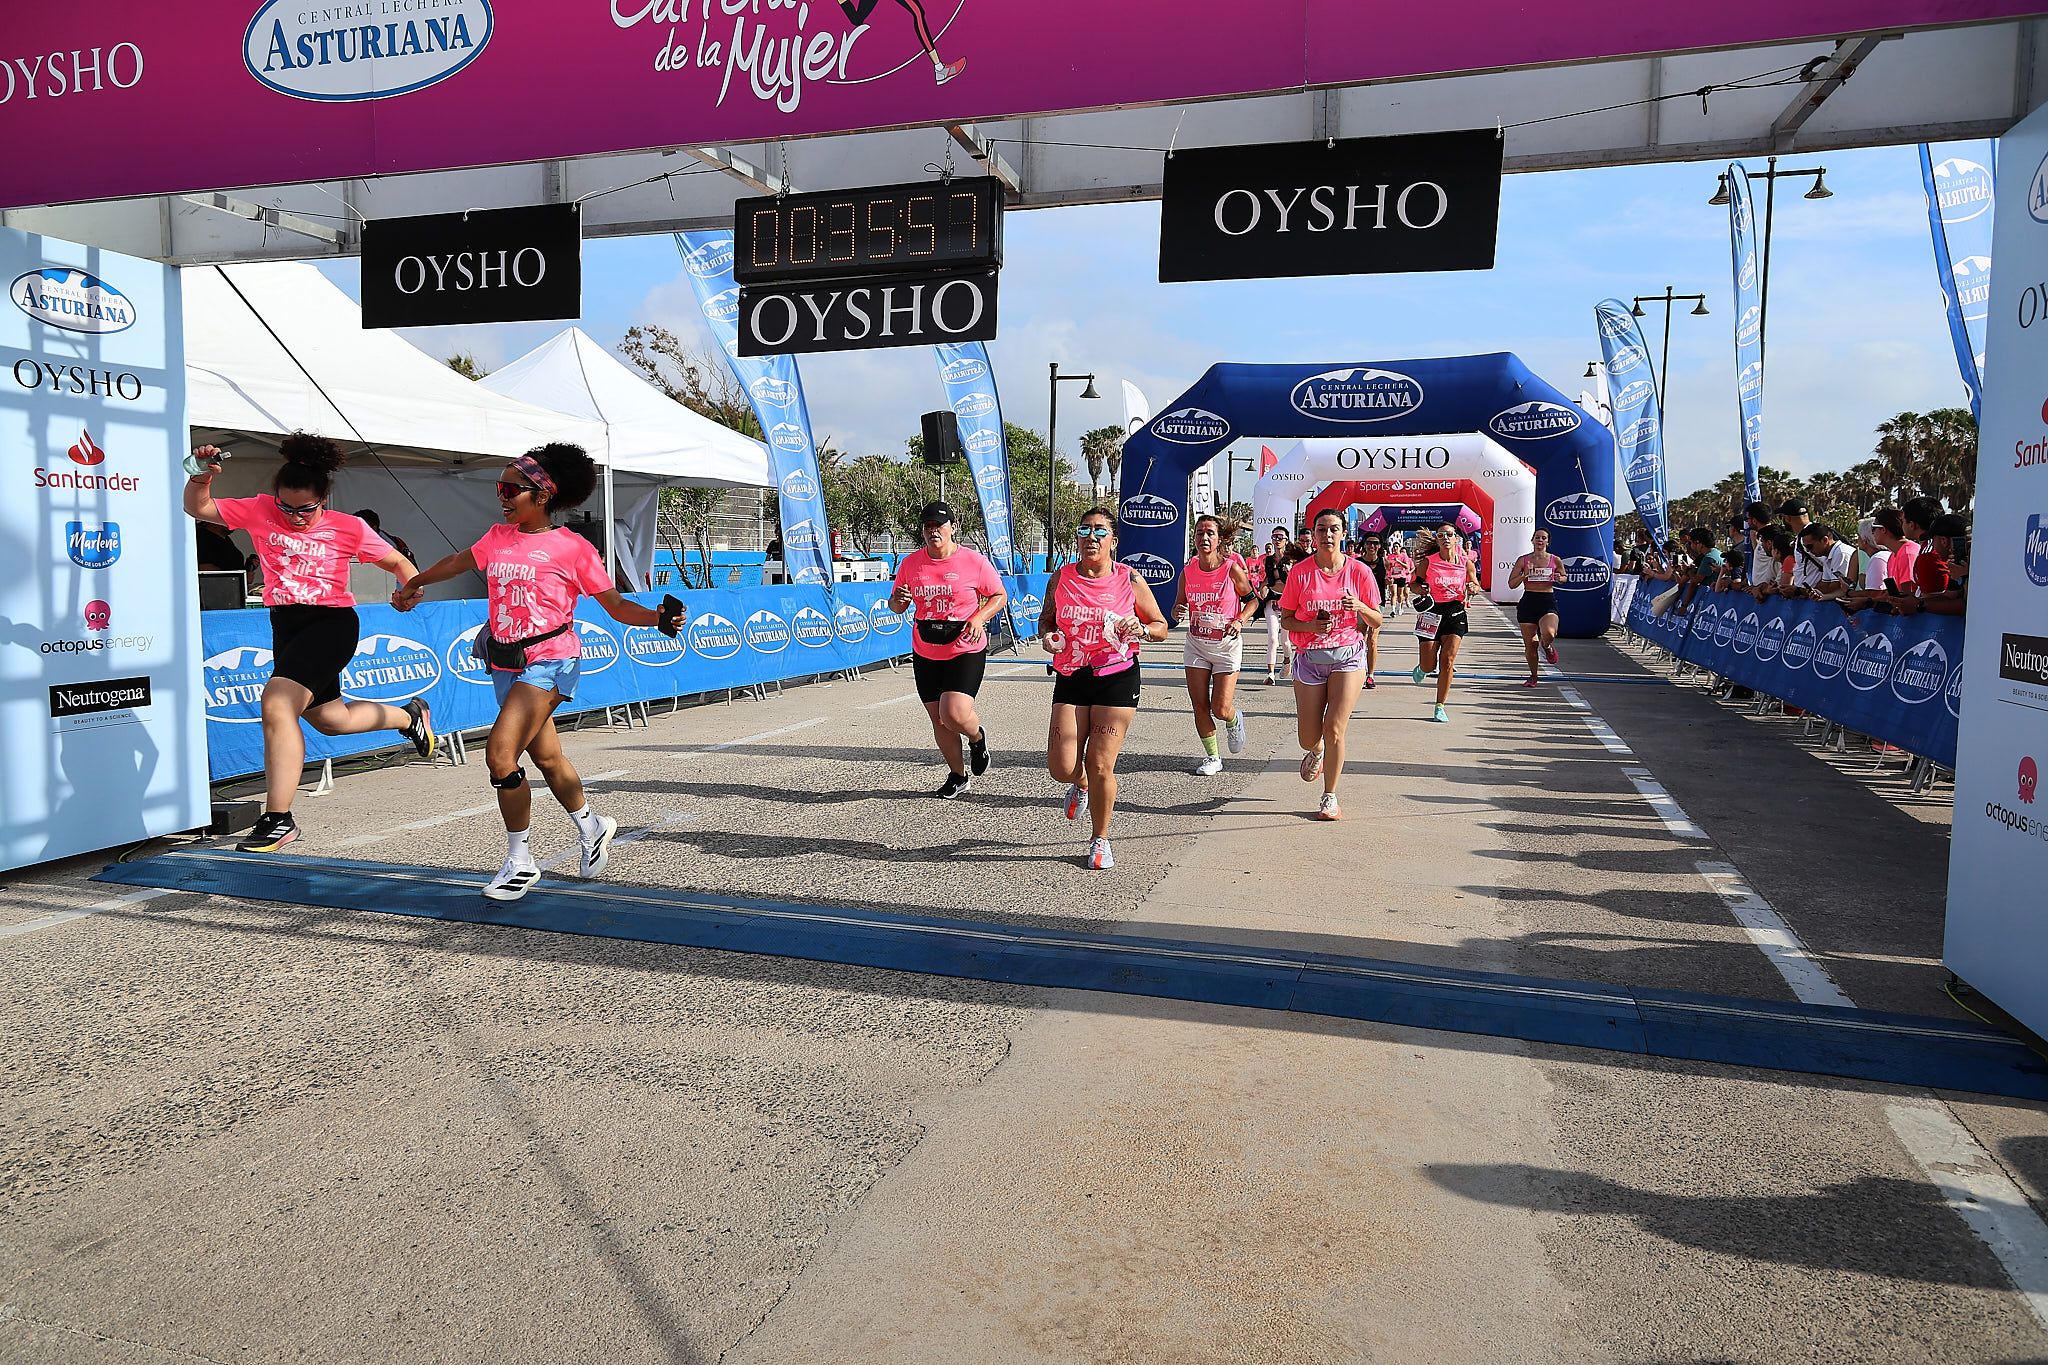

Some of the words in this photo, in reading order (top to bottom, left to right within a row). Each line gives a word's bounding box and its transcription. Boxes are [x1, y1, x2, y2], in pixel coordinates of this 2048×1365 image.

[298, 5, 372, 25] CENTRAL
[263, 13, 474, 72] ASTURIANA
[654, 27, 689, 71] de
[696, 22, 722, 68] la
[716, 10, 870, 113] Mujer
[1214, 181, 1448, 236] OYSHO
[752, 192, 977, 267] 00:35:57
[394, 247, 546, 294] OYSHO
[21, 283, 128, 324] ASTURIANA
[40, 284, 81, 298] CENTRAL
[84, 293, 123, 306] LECHERA
[751, 280, 983, 346] OYSHO
[14, 359, 142, 400] OYSHO
[1366, 382, 1410, 390] LECHERA
[1300, 386, 1414, 409] ASTURIANA
[1155, 420, 1223, 436] ASTURIANA
[1497, 416, 1576, 432] ASTURIANA
[1337, 446, 1450, 470] OYSHO
[34, 467, 139, 491] Santander
[1272, 473, 1304, 481] OYSHO
[1483, 469, 1518, 478] OYSHO
[1360, 481, 1391, 493] Sports
[1405, 480, 1456, 491] Santander
[1122, 505, 1174, 520] ASTURIANA
[1257, 516, 1287, 525] OYSHO
[1500, 516, 1534, 525] OYSHO
[1548, 506, 1610, 520] ASTURIANA
[70, 531, 119, 556] Marlene
[269, 532, 326, 558] CARRERA
[487, 562, 536, 581] CARRERA
[914, 584, 954, 597] CARRERA
[1188, 592, 1221, 602] CARRERA
[749, 627, 789, 643] ASTURIANA
[1199, 626, 1213, 634] 016
[40, 639, 104, 655] octopus
[105, 635, 153, 652] energy
[629, 637, 683, 656] ASTURIANA
[694, 632, 740, 650] ASTURIANA
[1784, 641, 1812, 659] ASTURIANA
[353, 657, 390, 668] CENTRAL
[392, 652, 429, 663] LECHERA
[1815, 642, 1845, 668] ASTURIANA
[1848, 650, 1887, 679] ASTURIANA
[213, 671, 258, 684] CENTRAL
[341, 661, 437, 690] ASTURIANA
[1894, 659, 1941, 691] ASTURIANA
[56, 687, 146, 709] Neutrogena
[1985, 802, 2028, 833] octopus
